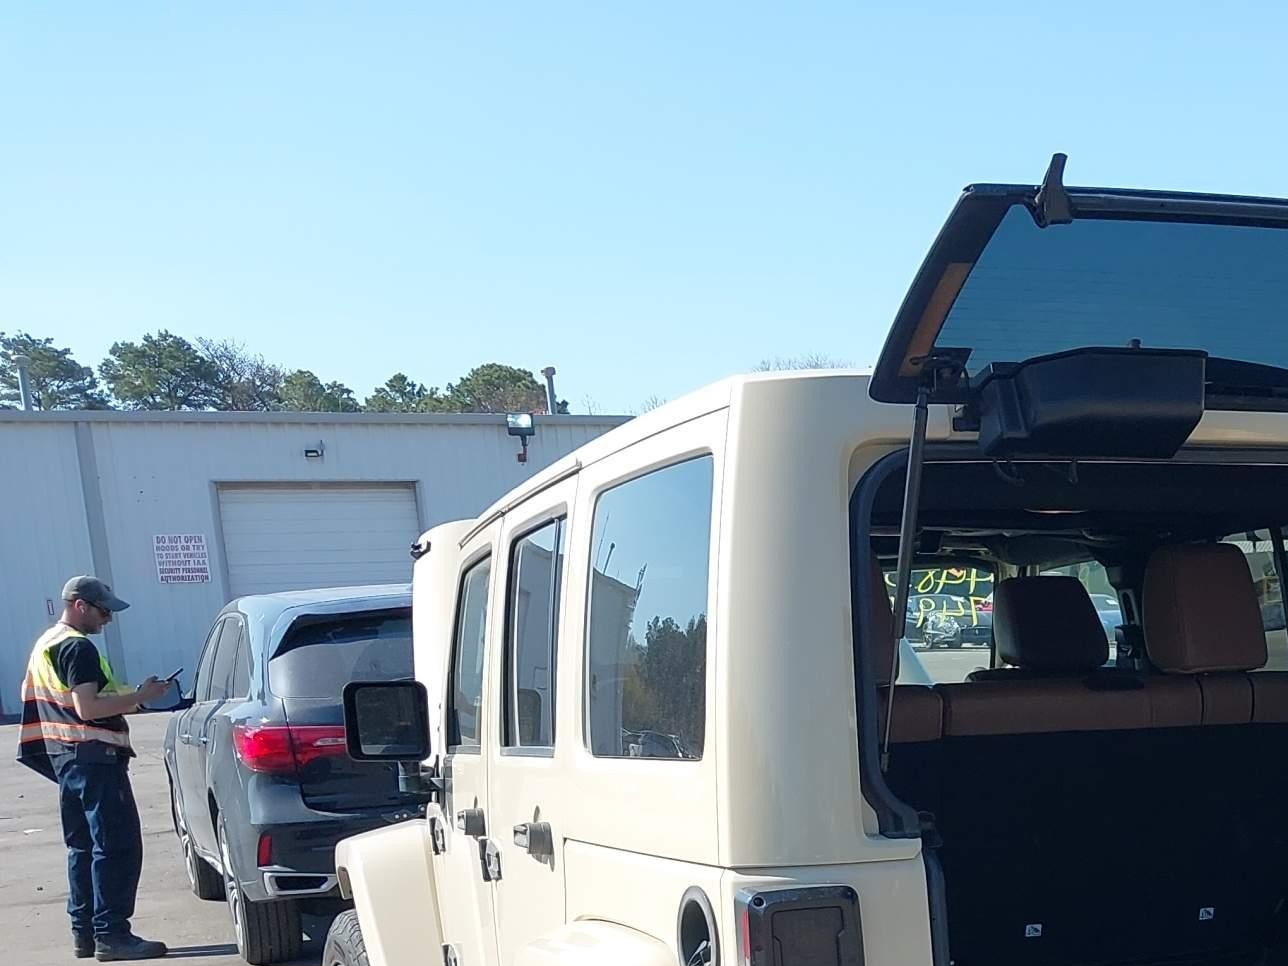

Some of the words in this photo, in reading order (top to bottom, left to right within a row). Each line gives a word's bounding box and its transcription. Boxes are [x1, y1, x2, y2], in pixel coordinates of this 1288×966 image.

[156, 535, 166, 544] DO
[167, 535, 182, 544] NOT
[183, 535, 203, 544] OPEN
[156, 544, 180, 552] HOODS
[158, 559, 191, 567] WITHOUT
[160, 574, 210, 583] AUTHORIZATION
